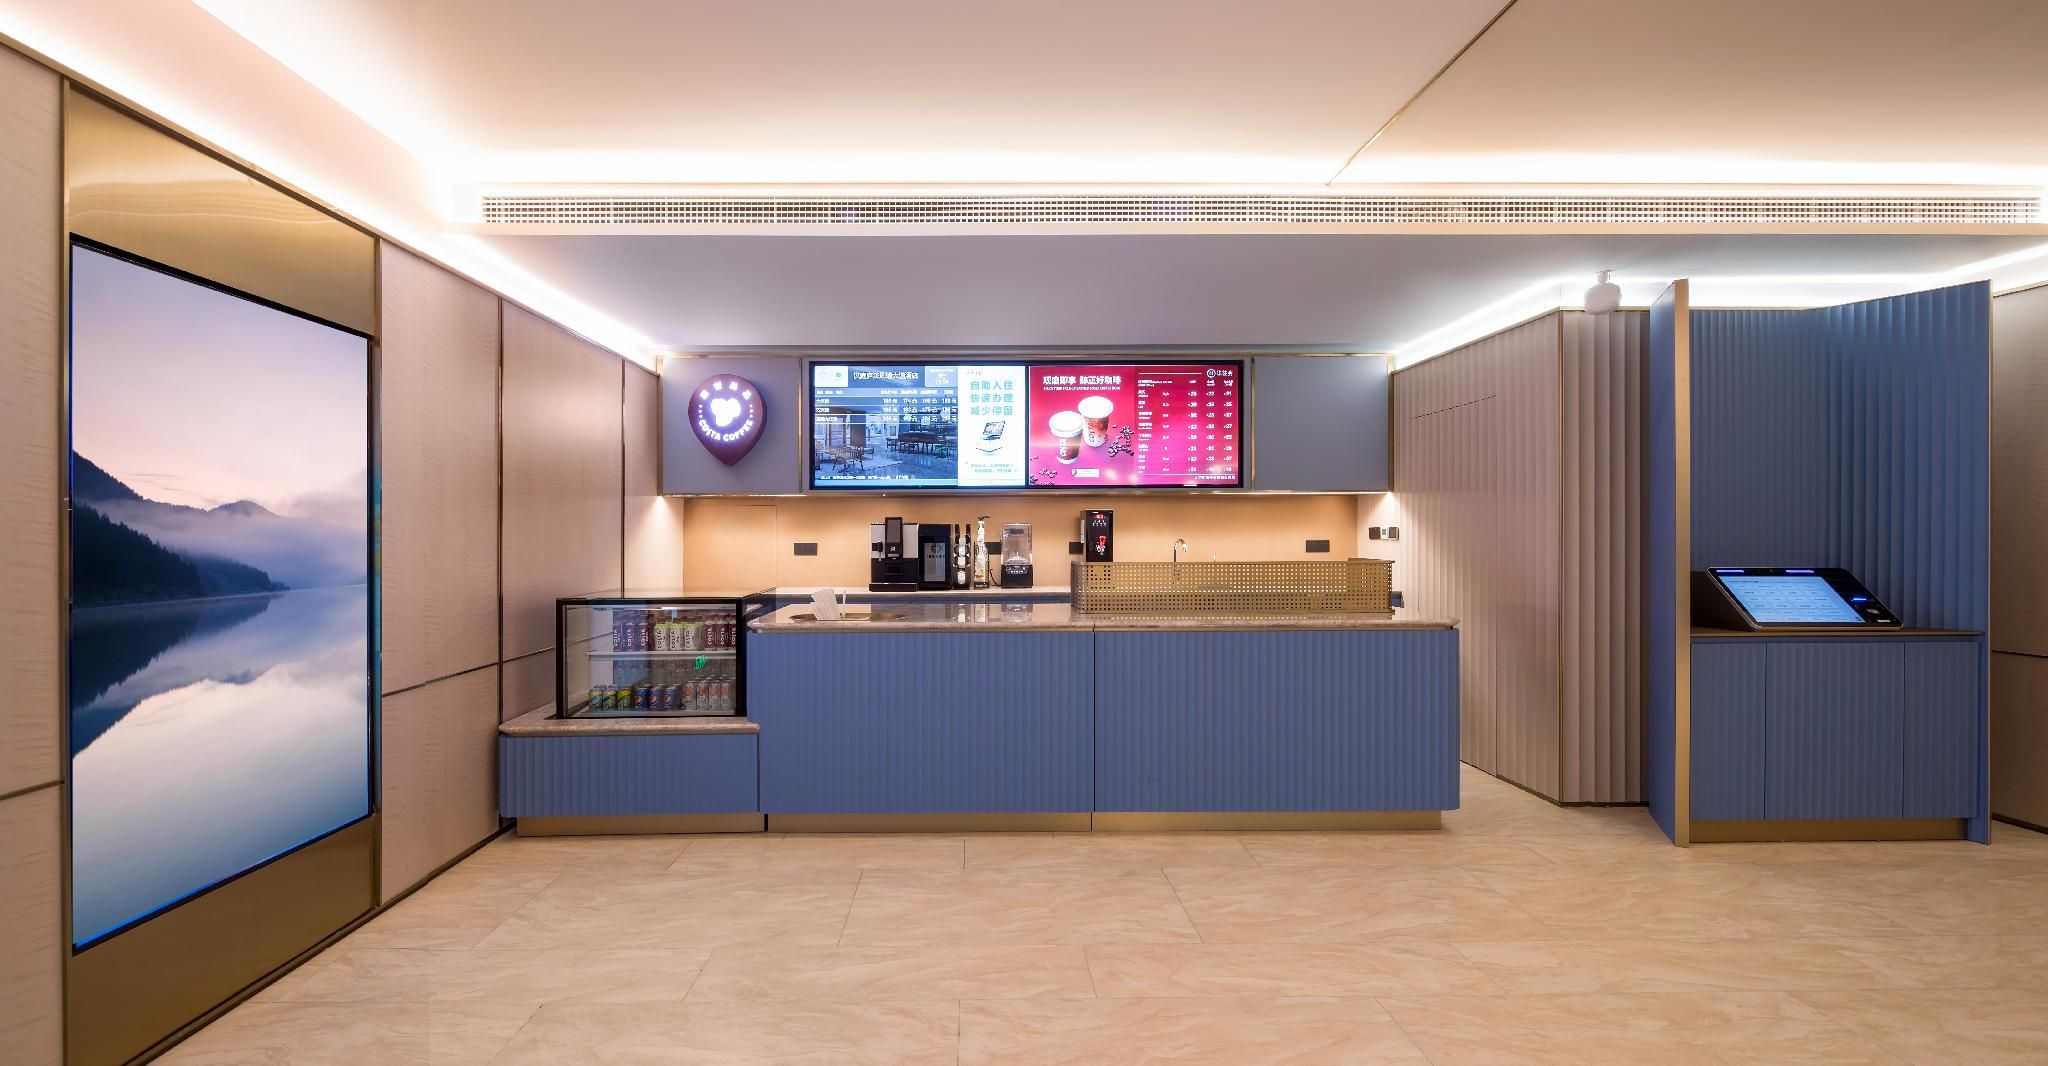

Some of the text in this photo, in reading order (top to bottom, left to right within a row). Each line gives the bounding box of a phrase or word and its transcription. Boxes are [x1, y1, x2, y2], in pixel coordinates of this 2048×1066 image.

[970, 380, 1014, 391] 自助入住
[970, 393, 1014, 403] 快速办理
[970, 405, 1013, 416] 减少停留
[699, 419, 753, 442] COSTA COFFEE
